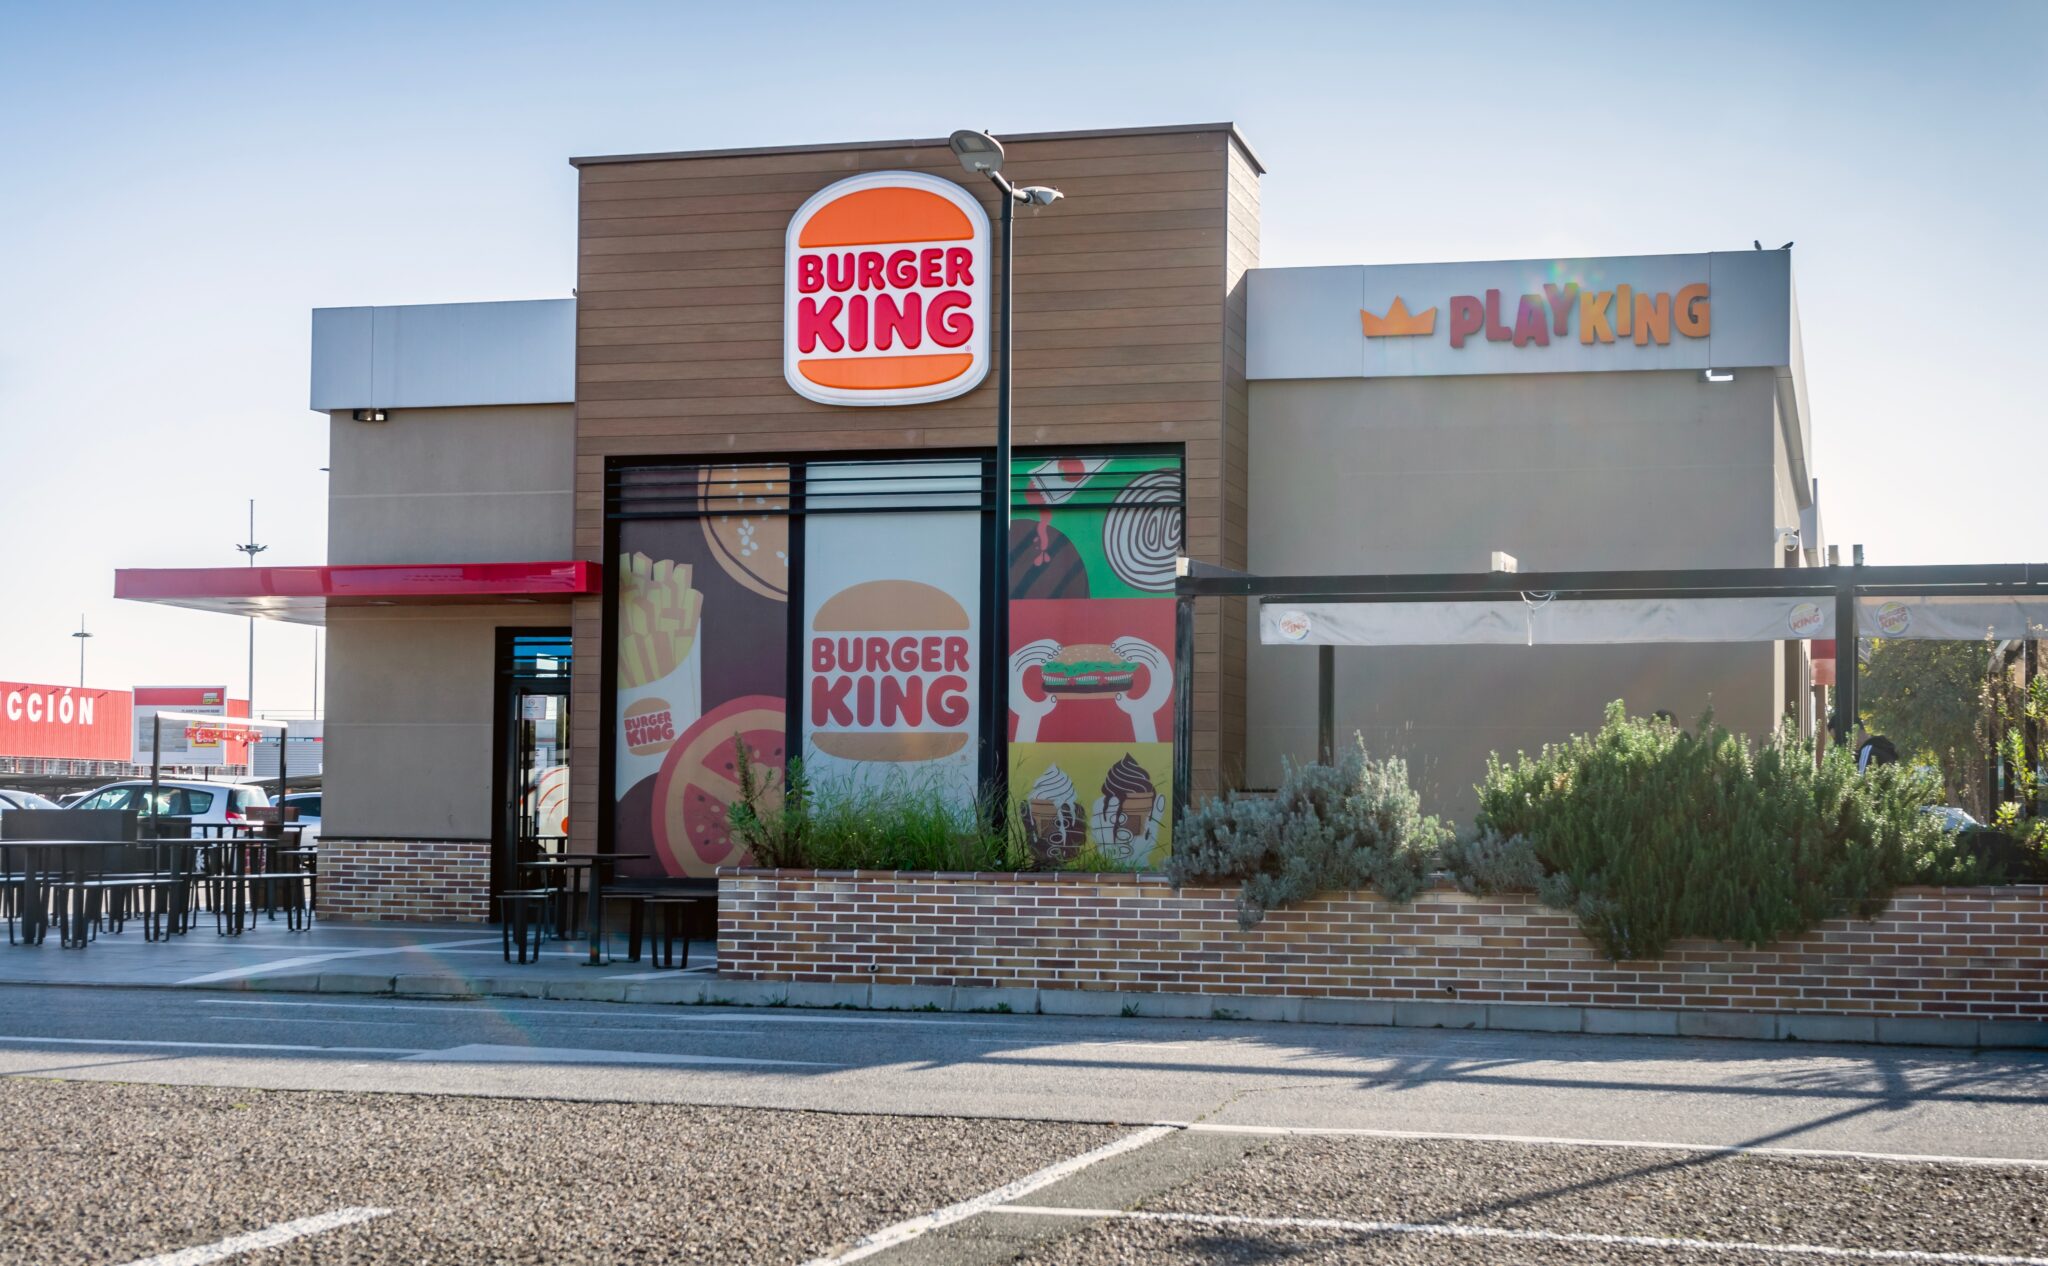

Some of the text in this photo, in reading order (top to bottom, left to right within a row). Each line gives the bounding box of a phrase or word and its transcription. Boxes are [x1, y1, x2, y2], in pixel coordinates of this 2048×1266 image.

[798, 247, 974, 293] BURGER
[798, 290, 974, 354] KING
[812, 636, 970, 672] BURGER
[0, 687, 94, 726] CCIÓN
[624, 711, 672, 730] BURGER
[811, 675, 970, 727] KING
[626, 722, 675, 747] KING
